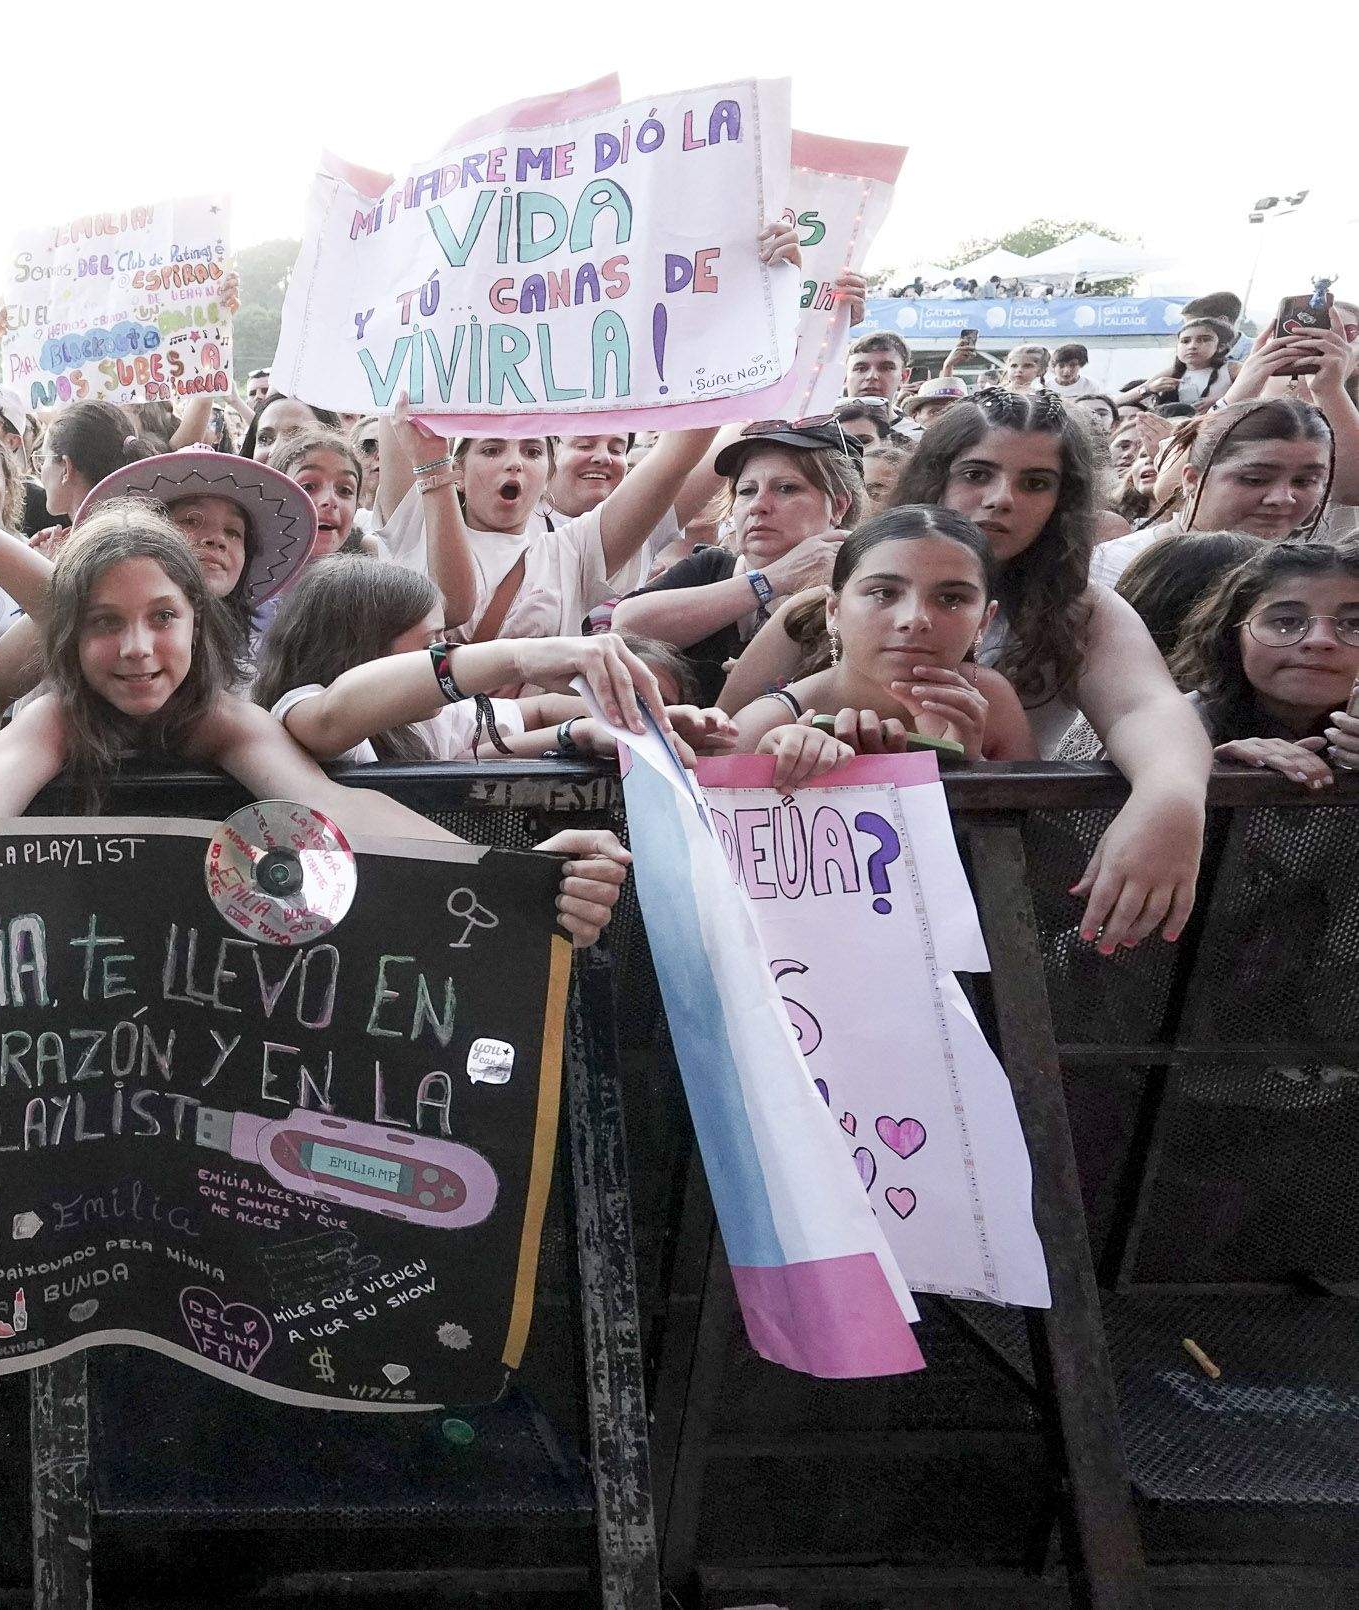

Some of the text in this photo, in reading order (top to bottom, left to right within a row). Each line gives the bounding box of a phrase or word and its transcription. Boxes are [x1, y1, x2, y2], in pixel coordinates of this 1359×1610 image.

[389, 146, 507, 224] MADRE
[516, 142, 576, 182] ME
[682, 100, 742, 152] LA
[77, 254, 114, 277] DEL
[149, 252, 163, 266] de
[354, 307, 375, 340] Y
[489, 254, 631, 315] GANAS
[665, 247, 721, 294] DE
[924, 318, 969, 330] CALIDADE
[926, 308, 961, 319] GALICIA
[1013, 317, 1058, 329] CALIDADE
[1015, 306, 1050, 317] GALICIA
[1102, 305, 1139, 316] GALICIA
[1103, 316, 1147, 328] CALIDADE
[30, 342, 221, 410] NOS SUBES A
[163, 922, 340, 1029] LLEVO
[366, 955, 455, 1048] EN
[473, 1043, 502, 1059] you
[201, 1029, 241, 1086] Y
[261, 1041, 334, 1112] EN
[375, 1059, 454, 1135] LA
[329, 1156, 401, 1184] EMILIA.MP
[199, 1185, 228, 1200] QUE
[317, 1214, 348, 1229] QUE
[105, 1238, 153, 1252] PELA
[44, 1263, 128, 1302] BUNDA
[288, 1276, 437, 1343] A VER SU SHOW
[321, 1288, 359, 1310] QUE
[189, 1300, 234, 1326] DEL
[190, 1317, 260, 1350] DE UNA
[202, 1337, 253, 1372] FAN
